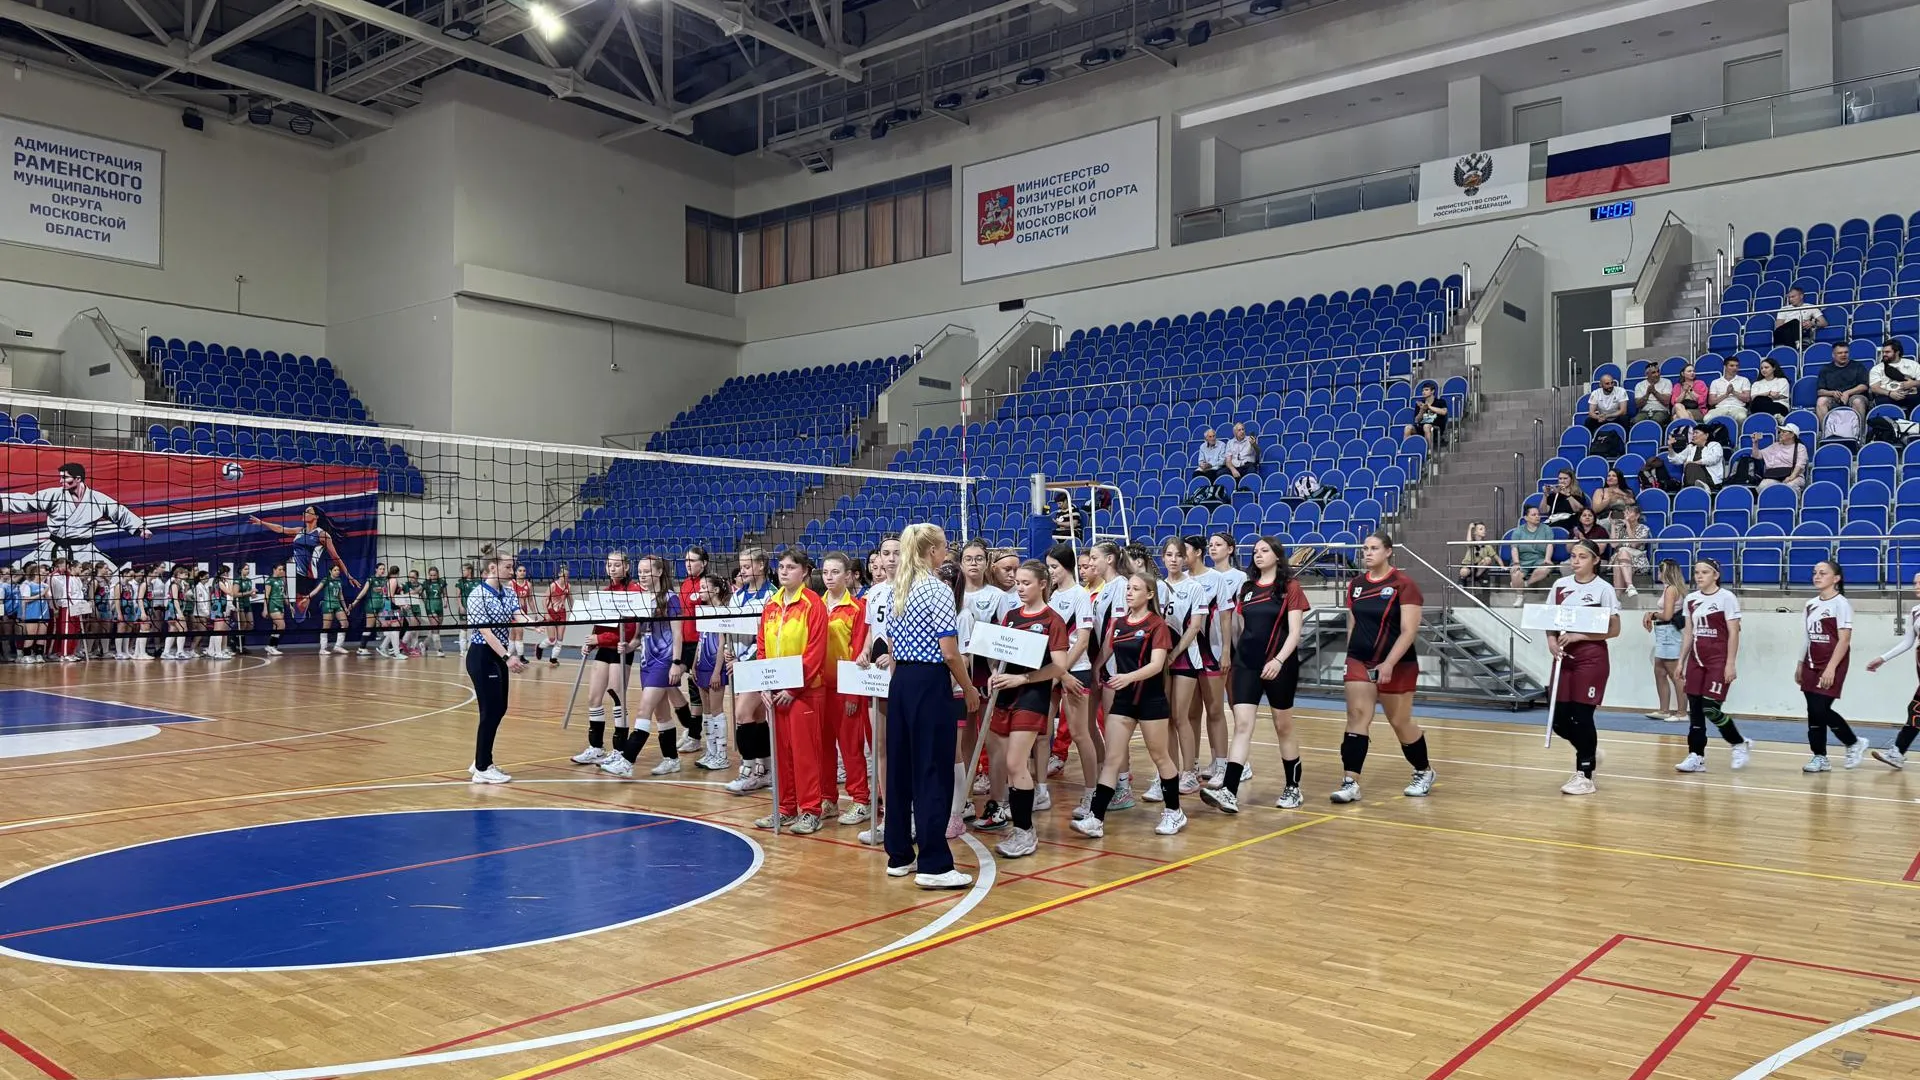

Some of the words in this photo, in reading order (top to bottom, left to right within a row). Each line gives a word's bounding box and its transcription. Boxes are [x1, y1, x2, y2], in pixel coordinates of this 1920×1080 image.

[14, 136, 143, 172] АДМИНИСТРАЦИЯ
[13, 151, 143, 190] РАМЕНСКОГО
[1016, 163, 1110, 194] МИНИСТЕРСТВО
[1016, 178, 1096, 206] ФИЗИЧЕСКОЙ
[1016, 197, 1075, 219] КУЛЬТУРЫ
[1078, 194, 1086, 206] И
[1089, 183, 1138, 203] СПОРТА
[51, 193, 103, 212] ОКРУГА
[1433, 206, 1473, 218] РОССИЙСКОЙ
[1473, 199, 1512, 211] ФЕДЕРАЦИИ
[1436, 198, 1483, 211] МИНИСТЕРСТВО
[1483, 194, 1508, 203] СПОРТА
[1596, 200, 1633, 219] 14:03
[29, 203, 126, 230] МОСКОВСКОЙ
[1016, 206, 1097, 231] МОСКОВСКОЙ
[45, 222, 111, 243] ОБЛАСТИ
[1016, 225, 1069, 244] ОБЛАСТИ
[1352, 586, 1363, 598] 19
[876, 605, 886, 623] 5
[1587, 686, 1596, 698] 8
[1708, 681, 1723, 695] 11
